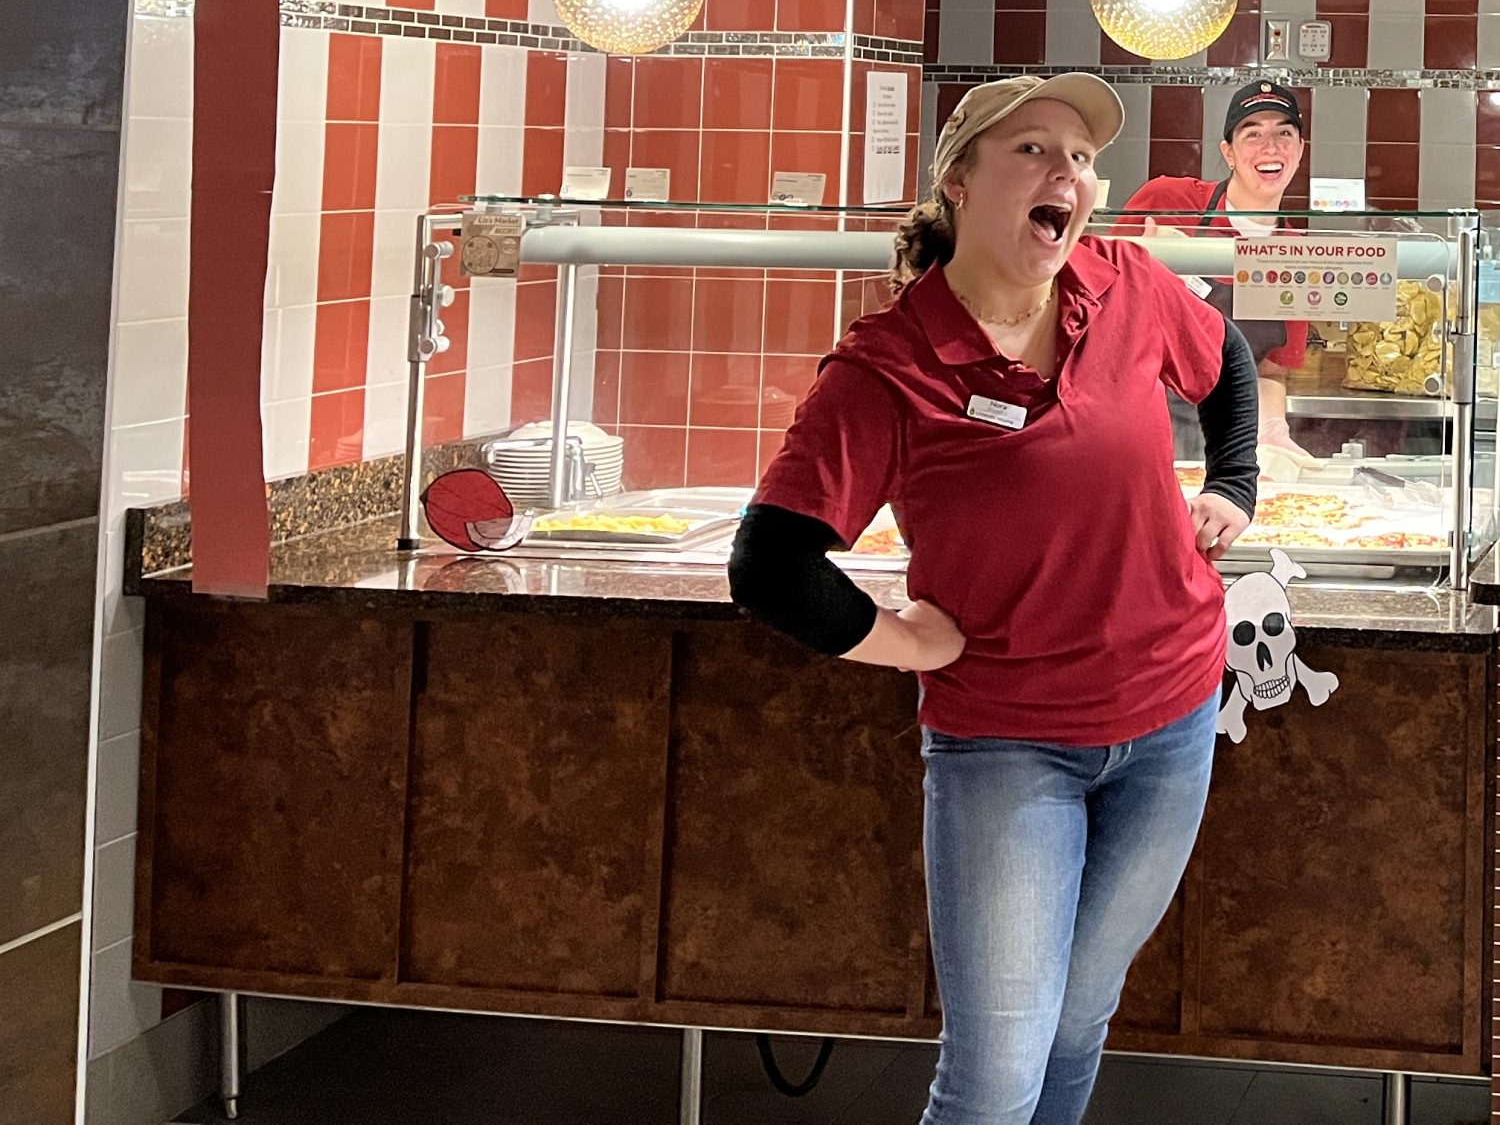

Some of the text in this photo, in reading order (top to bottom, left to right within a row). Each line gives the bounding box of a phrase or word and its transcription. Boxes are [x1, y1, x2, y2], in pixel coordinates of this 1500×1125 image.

[1236, 245, 1386, 257] WHAT'S IN YOUR FOOD
